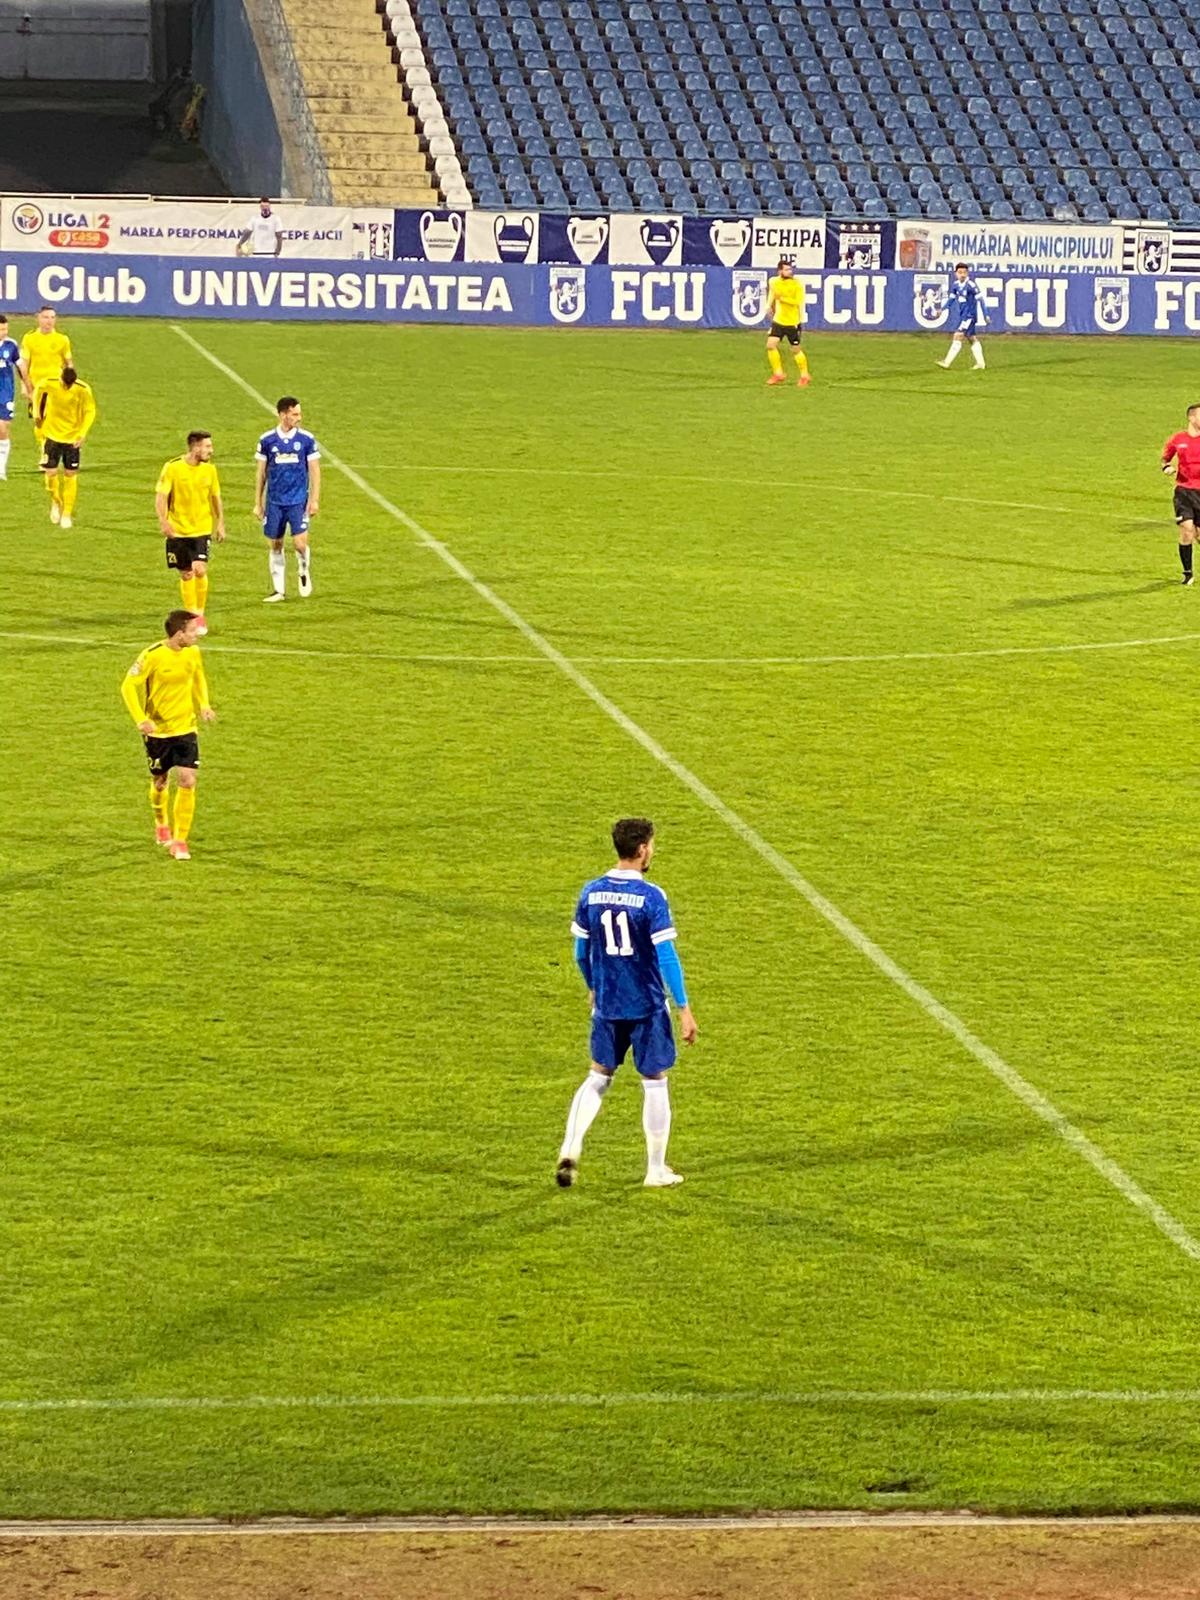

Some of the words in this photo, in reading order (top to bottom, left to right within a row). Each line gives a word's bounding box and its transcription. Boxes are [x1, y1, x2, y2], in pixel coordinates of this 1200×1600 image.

[48, 213, 88, 227] LIGA
[98, 214, 110, 229] 2
[120, 227, 164, 238] MAREA
[167, 228, 246, 239] PERFORMAN
[754, 229, 823, 248] ECHIPA
[942, 229, 1012, 256] PRIMĂRIA
[1016, 235, 1114, 259] MUNICIPIULUI
[37, 266, 147, 303] Club
[172, 269, 513, 311] UNIVERSITATEA
[611, 271, 706, 322] FCU
[799, 274, 887, 324] FCU
[975, 278, 1069, 328] FCU
[600, 909, 634, 956] 11
